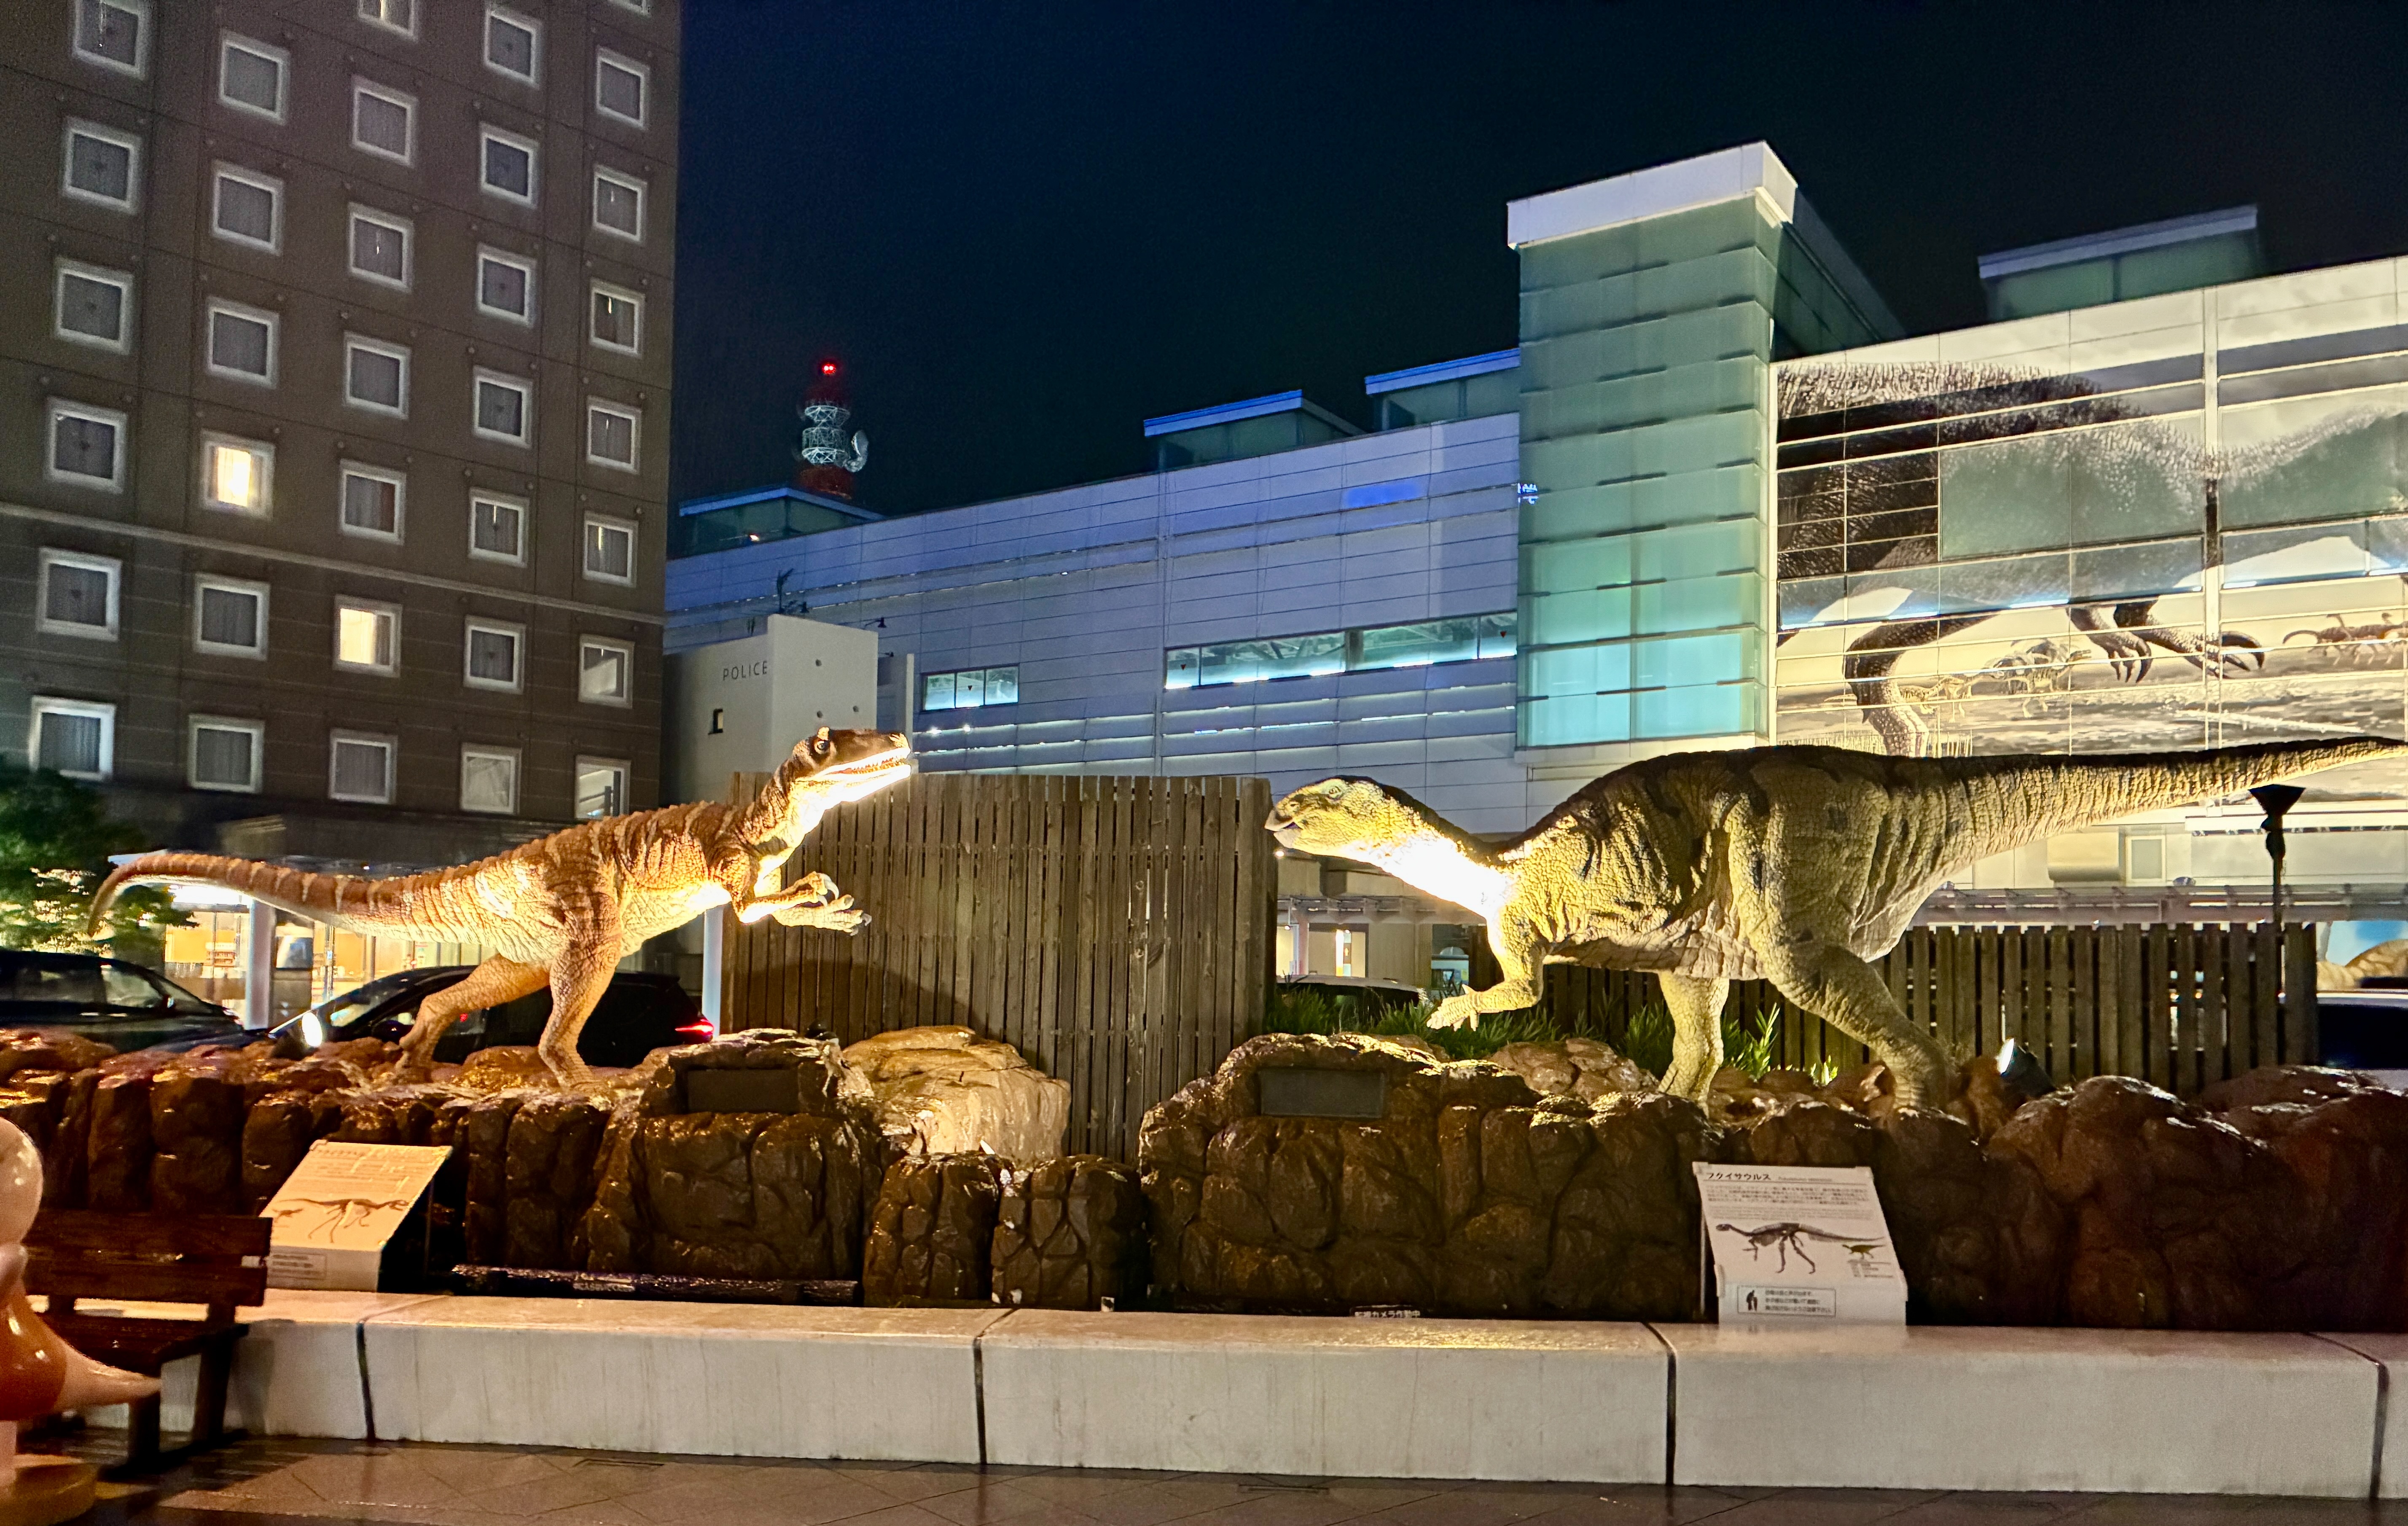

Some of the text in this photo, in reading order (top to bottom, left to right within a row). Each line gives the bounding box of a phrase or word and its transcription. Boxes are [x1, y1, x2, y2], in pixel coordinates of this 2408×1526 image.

[723, 661, 767, 680] POLICE
[1706, 1172, 1771, 1180] フクイサウルス
